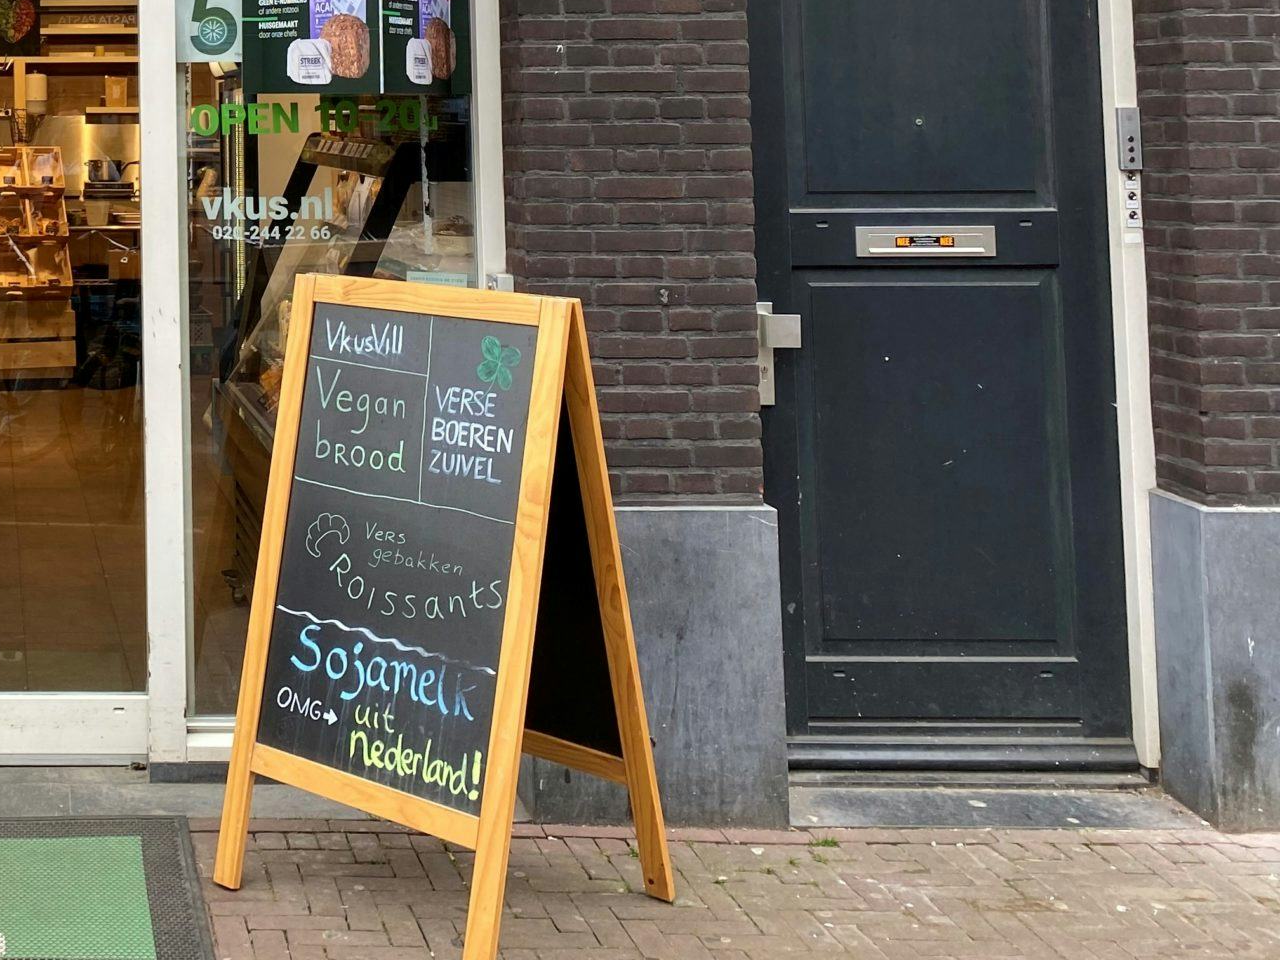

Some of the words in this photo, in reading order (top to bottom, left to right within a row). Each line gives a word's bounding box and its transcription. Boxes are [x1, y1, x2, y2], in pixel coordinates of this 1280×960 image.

[191, 102, 300, 136] OPEN
[200, 187, 333, 221] vkus.nl
[287, 225, 306, 240] 22
[310, 225, 331, 240] 66
[317, 365, 406, 435] Vegan
[434, 384, 497, 418] VERSE
[431, 417, 514, 454] BOEREN
[428, 449, 502, 483] ZUIVEL
[368, 548, 463, 576] gebakken
[290, 625, 477, 721] Sojamelk
[277, 686, 323, 721] OMG
[355, 702, 395, 734] uit
